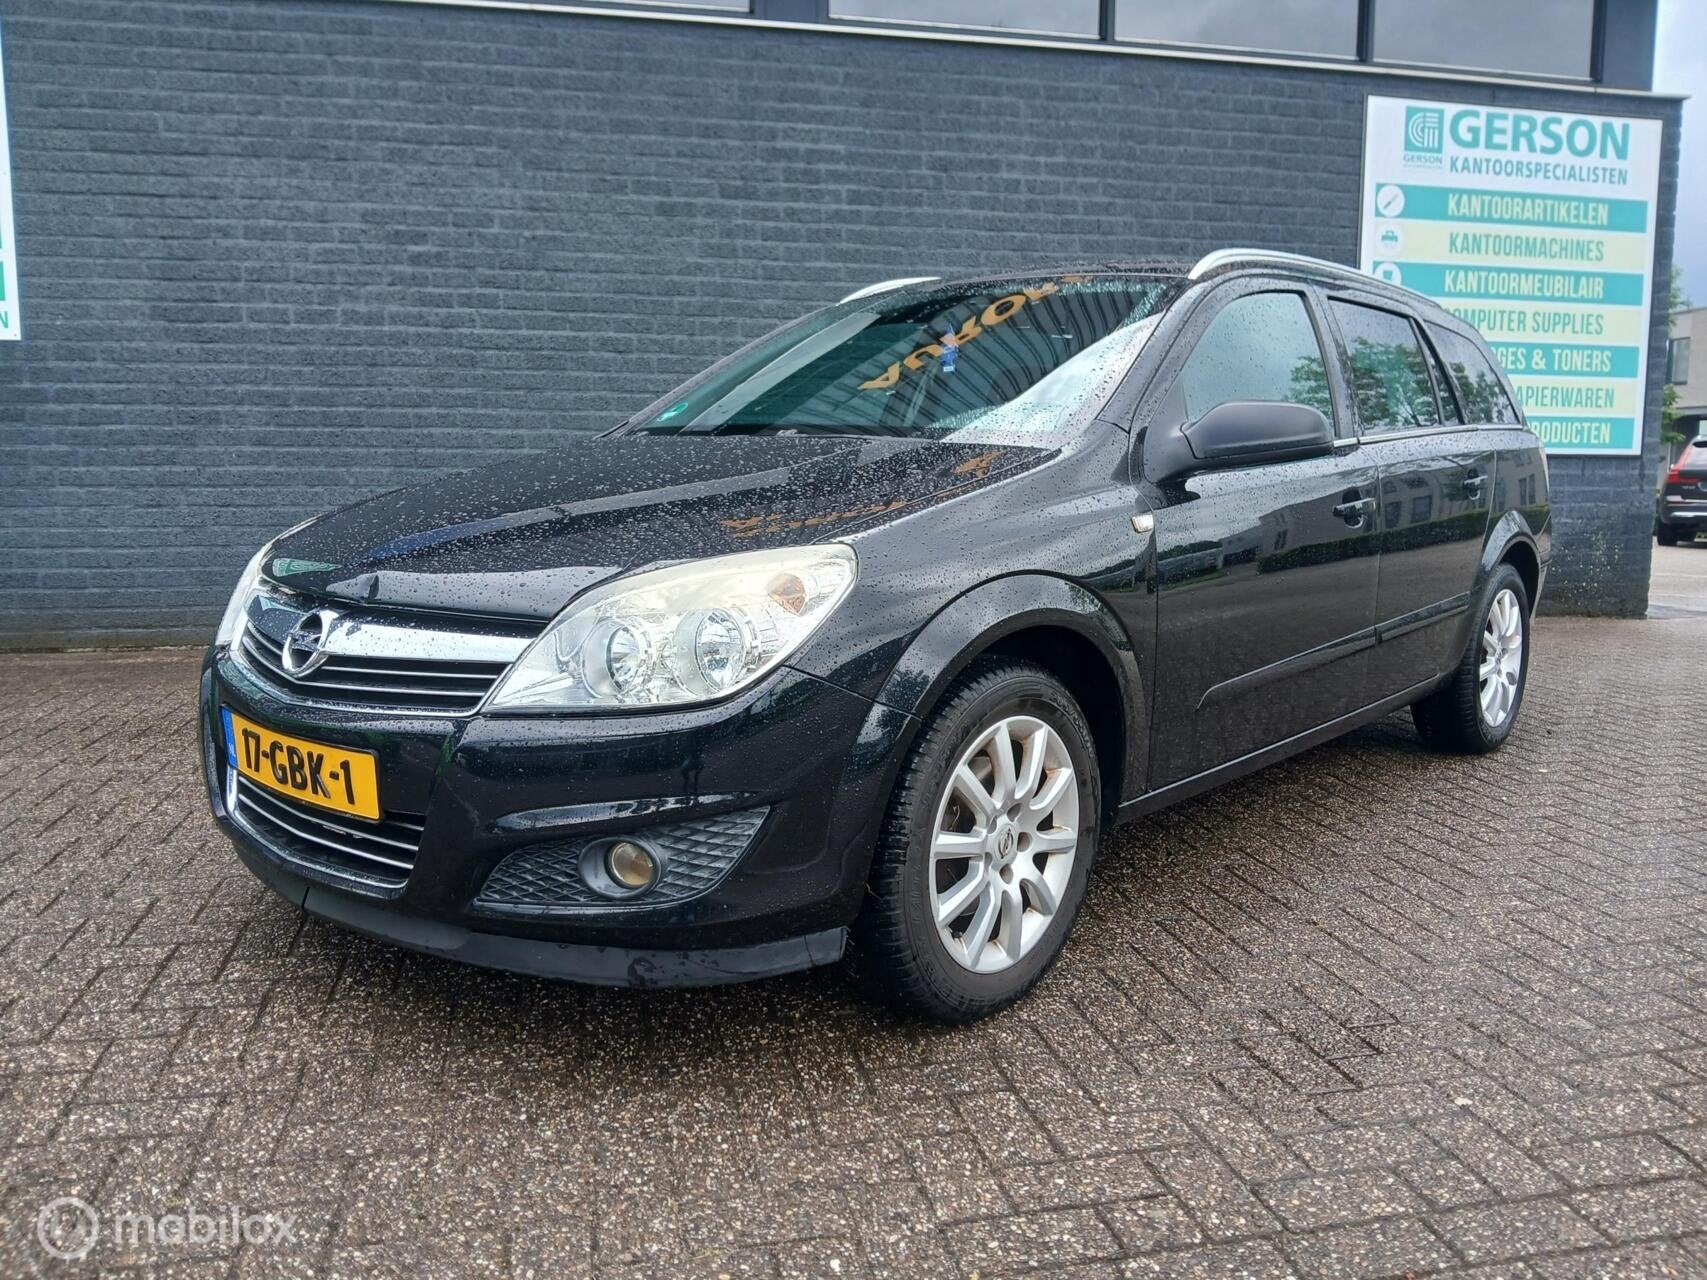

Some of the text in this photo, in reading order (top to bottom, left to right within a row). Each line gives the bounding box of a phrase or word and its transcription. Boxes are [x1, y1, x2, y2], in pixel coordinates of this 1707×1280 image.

[1450, 109, 1630, 161] GERSON
[1403, 154, 1443, 165] GERSON
[1450, 156, 1628, 186] KANTOORSPECIALISTEN
[1448, 193, 1609, 226] KANTOORARTIKELEN
[1449, 232, 1605, 262] KANTOORMACHINES
[1444, 270, 1604, 298] KANTOORMEUBILAIR
[1445, 307, 1604, 335] OMPUTER SUPPLIES
[1490, 346, 1612, 373] GES & TONERS
[1515, 385, 1615, 409] APIERWAREN
[1528, 421, 1611, 444] RODUCTEN
[241, 726, 356, 805] 17-GBK-1
